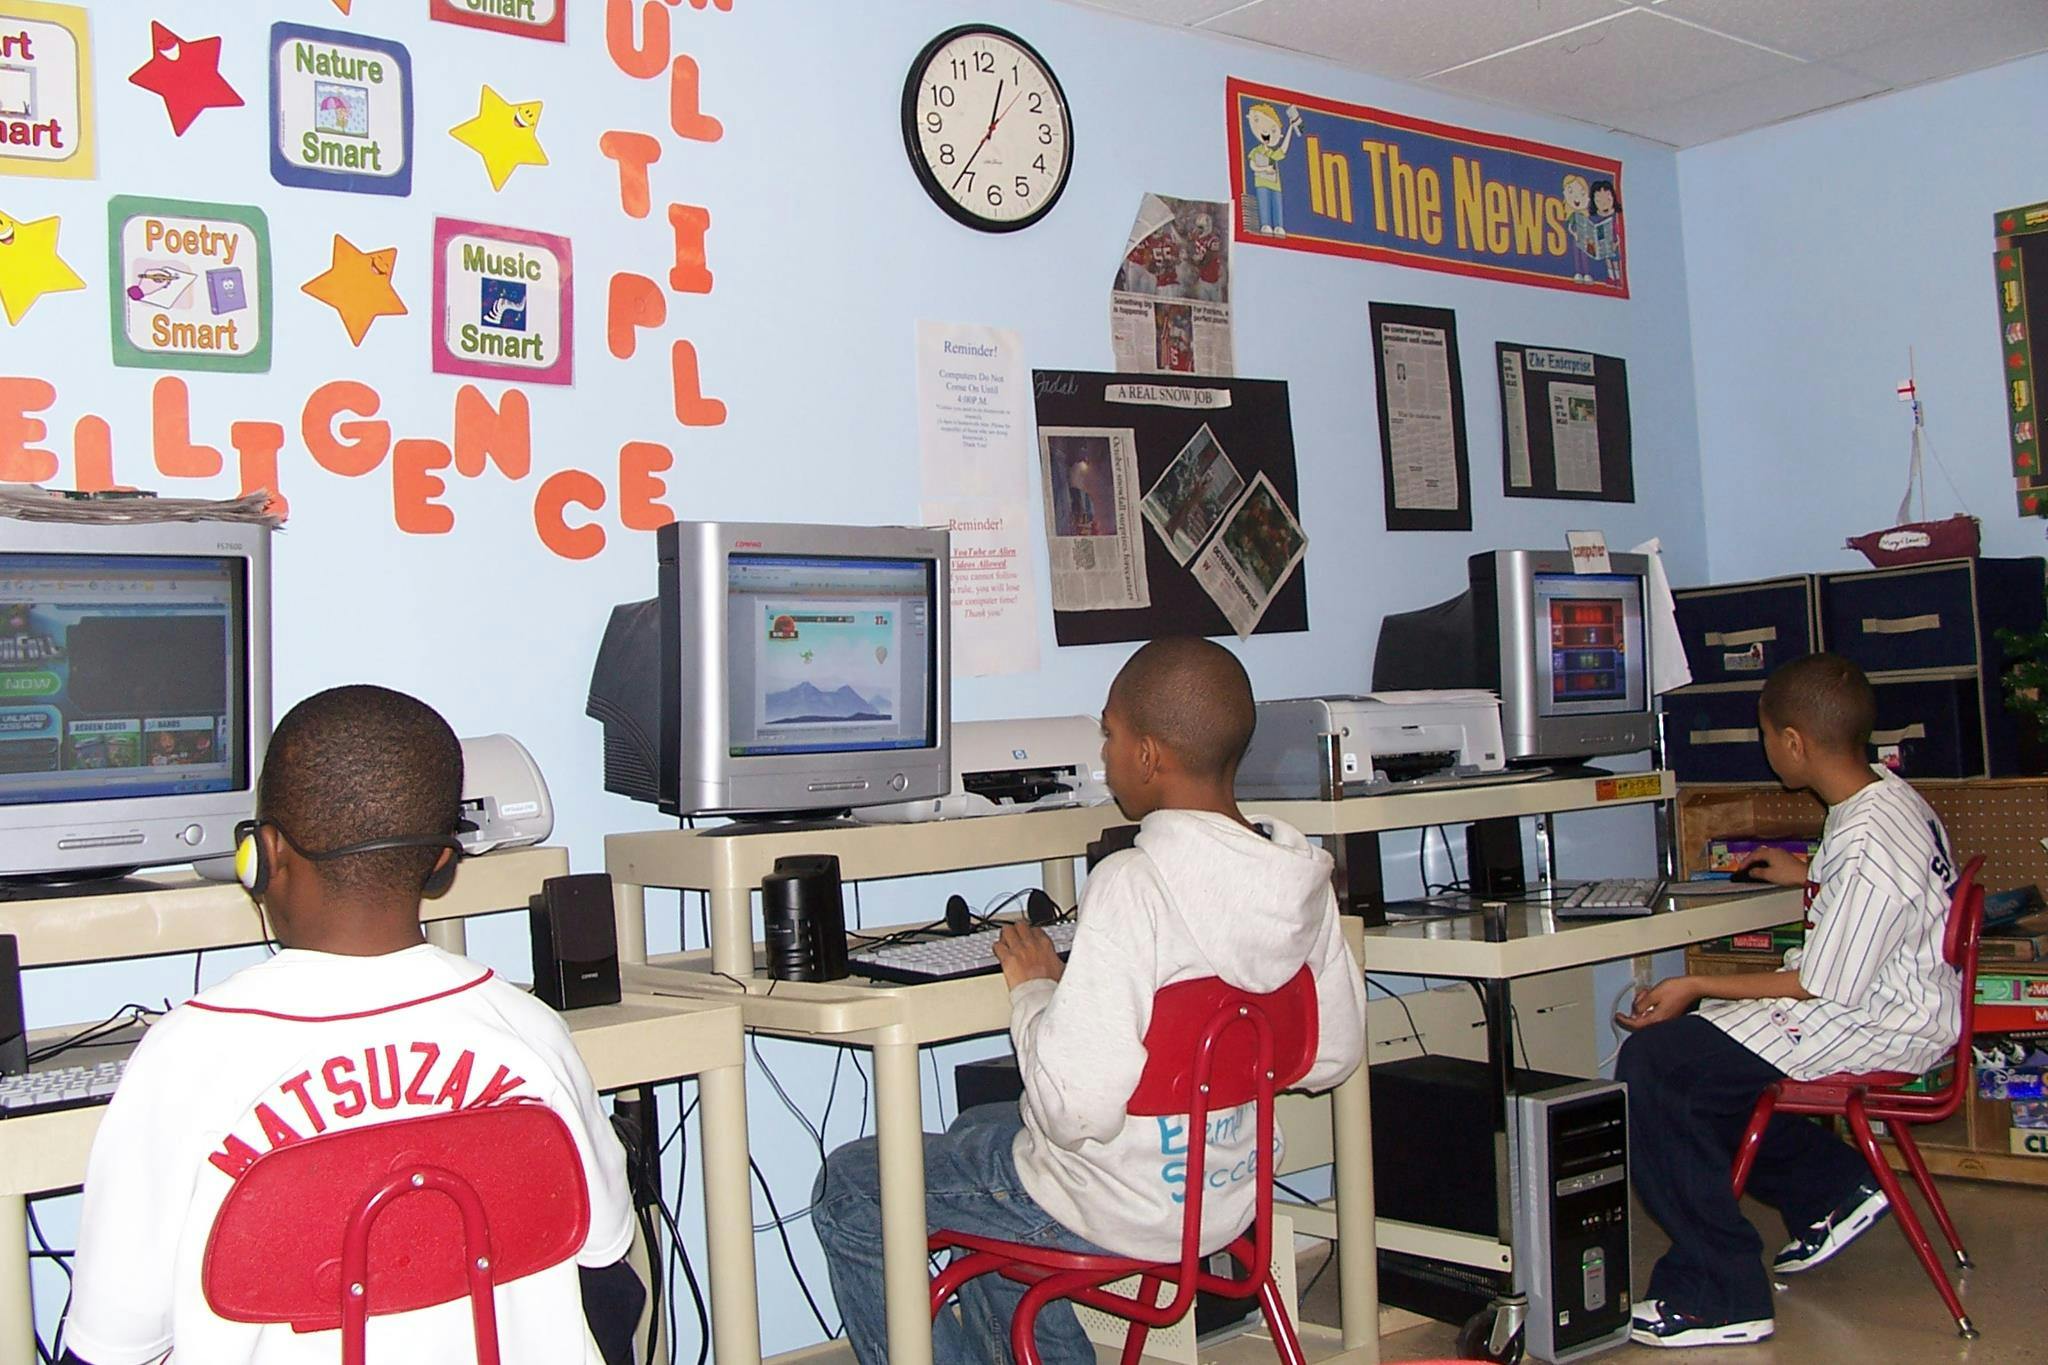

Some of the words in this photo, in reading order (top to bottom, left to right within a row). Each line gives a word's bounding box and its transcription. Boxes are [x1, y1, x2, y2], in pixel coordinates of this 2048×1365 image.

[0, 31, 34, 60] rt
[296, 42, 383, 84] Nature
[950, 58, 967, 81] 11
[972, 51, 995, 73] 12
[1012, 64, 1019, 86] 1
[931, 85, 955, 107] 10
[1028, 92, 1042, 114] 2
[0, 119, 63, 148] art
[926, 112, 943, 133] 9
[1038, 124, 1052, 145] 3
[302, 131, 382, 171] Smart
[940, 143, 955, 165] 8
[1032, 153, 1046, 174] 4
[963, 171, 976, 193] 7
[1015, 176, 1030, 197] 5
[987, 185, 1002, 206] 6
[1306, 136, 1352, 223] In
[1362, 140, 1443, 246] The
[1452, 155, 1568, 256] News
[145, 220, 239, 265] Poetry
[463, 243, 542, 281] Music
[152, 313, 239, 351] Smart
[460, 324, 544, 361] Smart
[944, 340, 998, 358] Reminder!
[1529, 352, 1545, 368] The
[1547, 354, 1592, 374] Enterprise
[939, 369, 977, 381] Computers
[979, 372, 990, 381] Do
[946, 383, 966, 392] Come
[1118, 386, 1127, 399] A
[1129, 386, 1157, 401] REAL
[1160, 388, 1192, 403] SNOW
[1194, 390, 1213, 406] JOB
[949, 518, 1003, 531] Reminder!
[1573, 544, 1605, 562] computer
[6, 678, 51, 689] NOW
[208, 1041, 543, 1180] MATSUZAK
